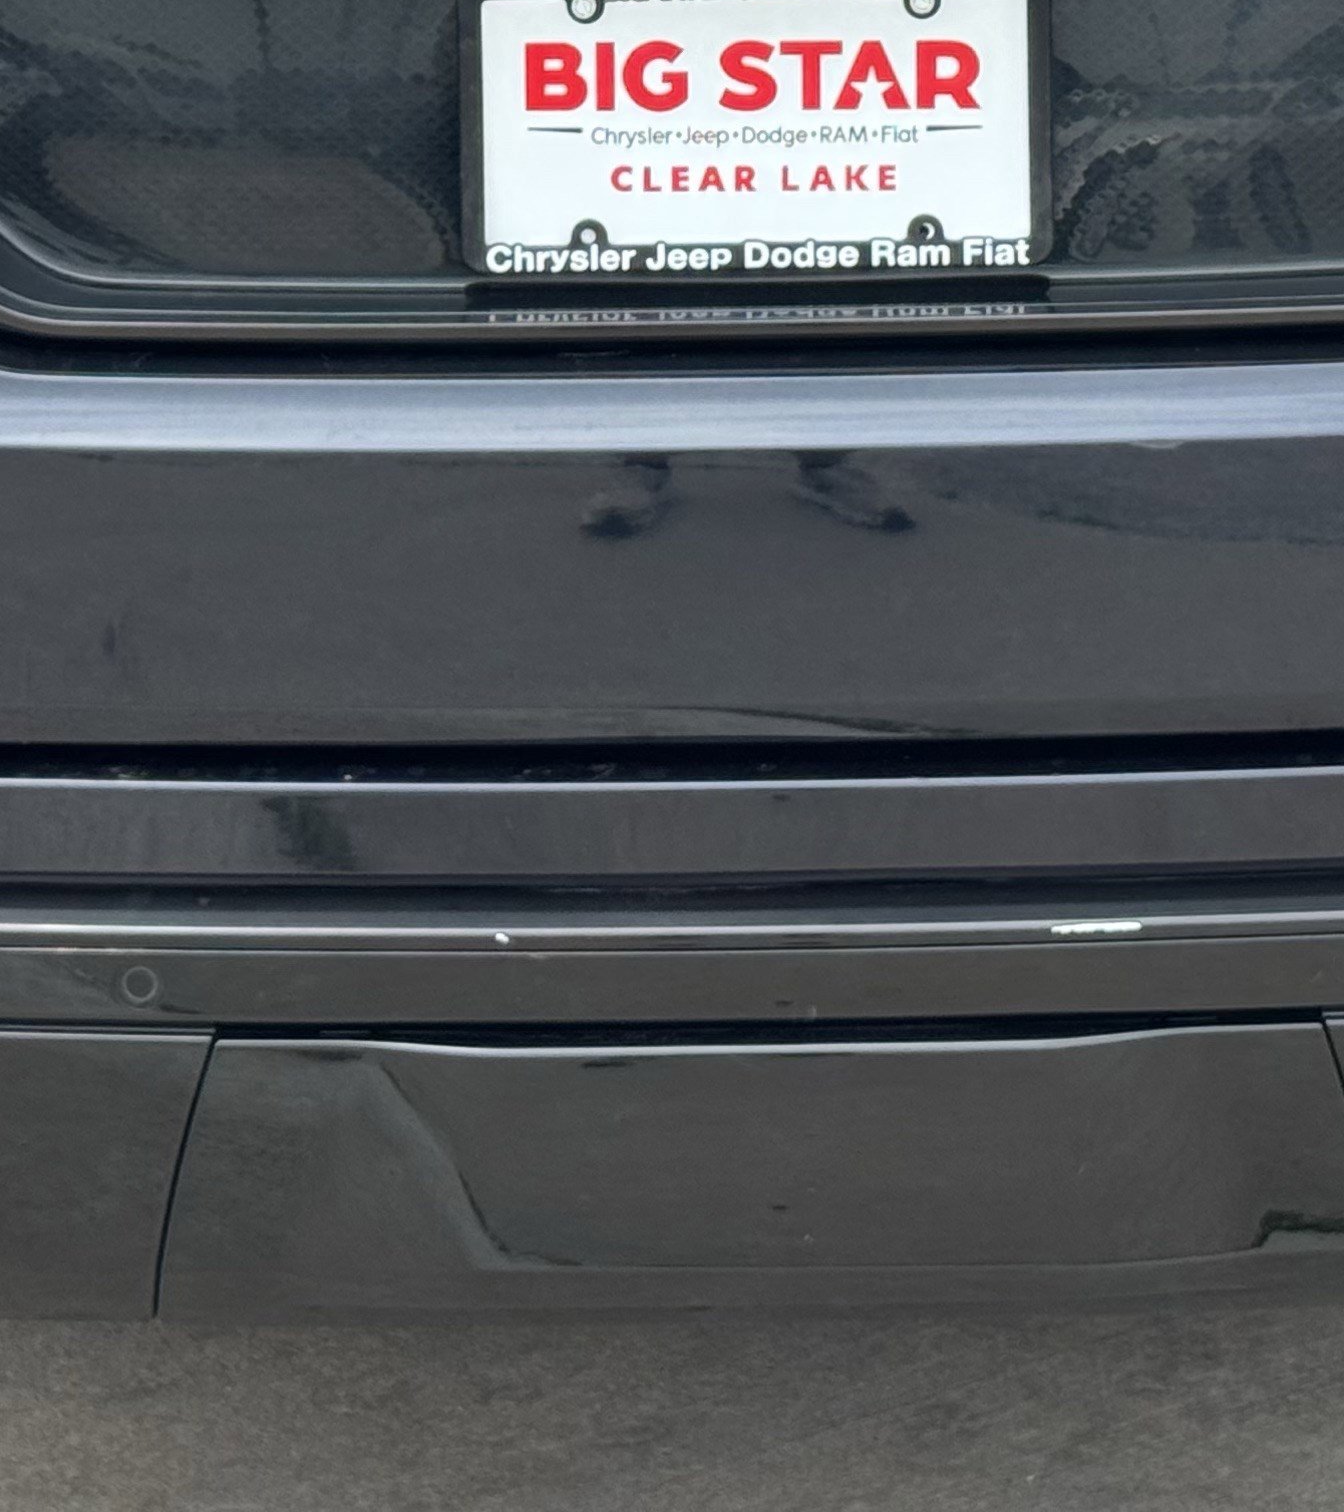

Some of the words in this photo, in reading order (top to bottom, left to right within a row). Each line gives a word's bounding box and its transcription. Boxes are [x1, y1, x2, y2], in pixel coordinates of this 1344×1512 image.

[524, 41, 689, 112] BIG
[719, 39, 982, 110] STAR
[611, 165, 757, 192] CLEAR
[782, 164, 897, 191] LAKE
[486, 243, 636, 274] Chrysler
[645, 242, 732, 272] Jeep
[744, 240, 859, 270] Dodge
[871, 239, 950, 268] Ram
[963, 237, 1031, 267] Fiat
